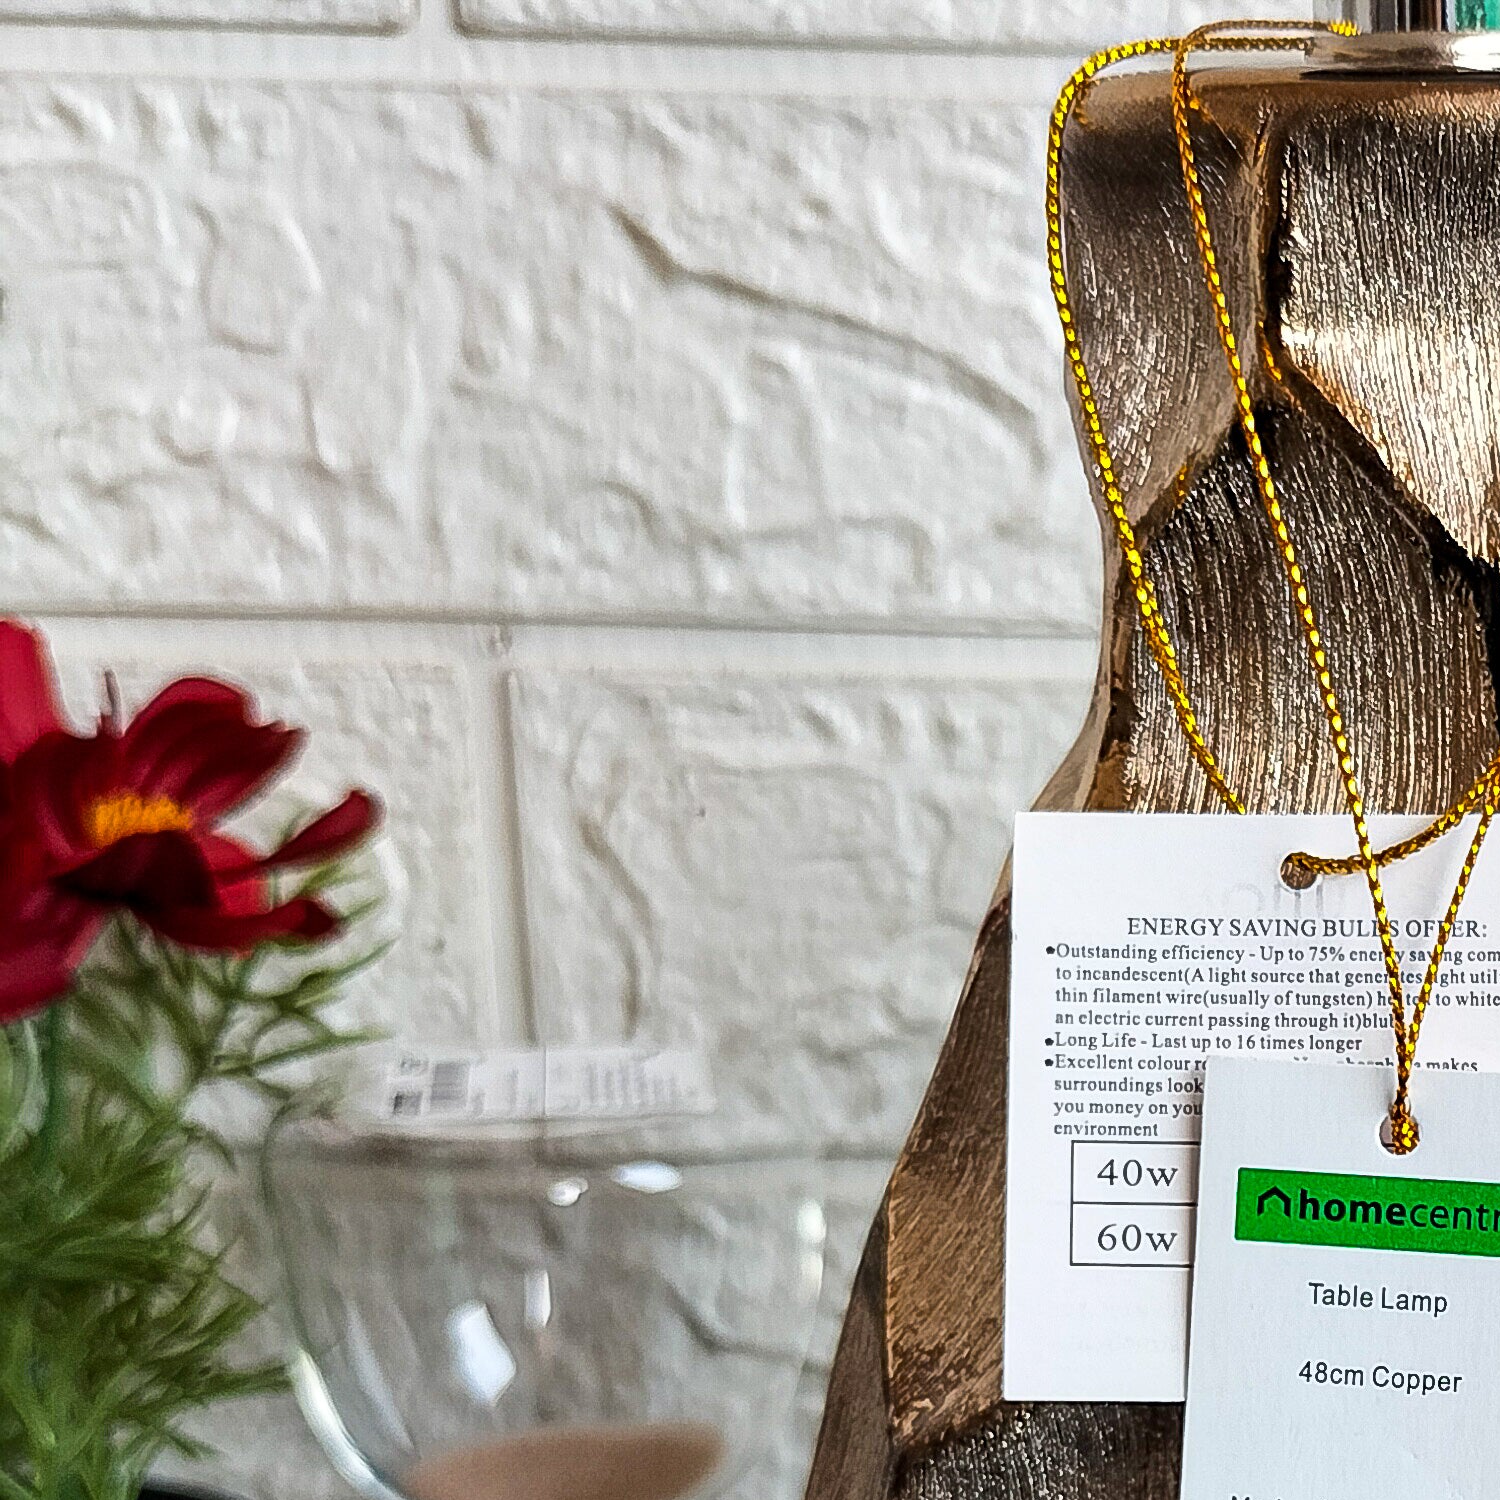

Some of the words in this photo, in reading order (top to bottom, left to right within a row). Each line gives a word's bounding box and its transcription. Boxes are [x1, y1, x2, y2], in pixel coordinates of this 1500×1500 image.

[1127, 917, 1224, 937] ENERGY
[1229, 918, 1317, 938] SAVING
[1056, 942, 1158, 963] Outstanding
[1161, 944, 1245, 964] efficiency
[1260, 945, 1285, 964] Up
[1288, 948, 1305, 961] to
[1308, 946, 1346, 962] 75%
[1349, 949, 1405, 964] enery
[1408, 948, 1463, 965] savng
[1056, 967, 1072, 980] to
[1208, 967, 1247, 986] light
[1250, 971, 1305, 984] source
[1308, 969, 1341, 984] that
[1344, 971, 1423, 987] genertes
[1433, 969, 1466, 987] ight
[1055, 987, 1088, 1003] thin
[1093, 987, 1162, 1004] filament
[1274, 990, 1293, 1005] of
[1295, 991, 1373, 1010] tungsten)
[1377, 991, 1431, 1007] hete
[1435, 992, 1451, 1006] to
[1455, 991, 1500, 1007] white
[1055, 1014, 1074, 1024] an
[1078, 1010, 1141, 1026] electric
[1144, 1013, 1205, 1027] current
[1208, 1012, 1271, 1031] passing
[1274, 1012, 1339, 1031] through
[1055, 1032, 1098, 1050] Long
[1102, 1033, 1137, 1048] Life
[1152, 1034, 1187, 1048] Last
[1191, 1037, 1212, 1052] up
[1215, 1036, 1232, 1049] to
[1237, 1035, 1256, 1050] 16
[1260, 1035, 1305, 1050] times
[1309, 1036, 1363, 1053] longer
[1055, 1054, 1133, 1070] Excellent
[1137, 1056, 1191, 1071] colour
[1054, 1076, 1163, 1097] surroundings
[1053, 1100, 1084, 1117] you
[1089, 1101, 1144, 1119] money
[1148, 1104, 1168, 1115] on
[1053, 1120, 1159, 1137] environment
[1097, 1158, 1179, 1187] 40w
[1097, 1223, 1178, 1252] 60w
[1308, 1281, 1374, 1308] Table
[1381, 1286, 1448, 1318] Lamp
[1298, 1360, 1365, 1387] 48cm
[1372, 1365, 1463, 1396] Copper
